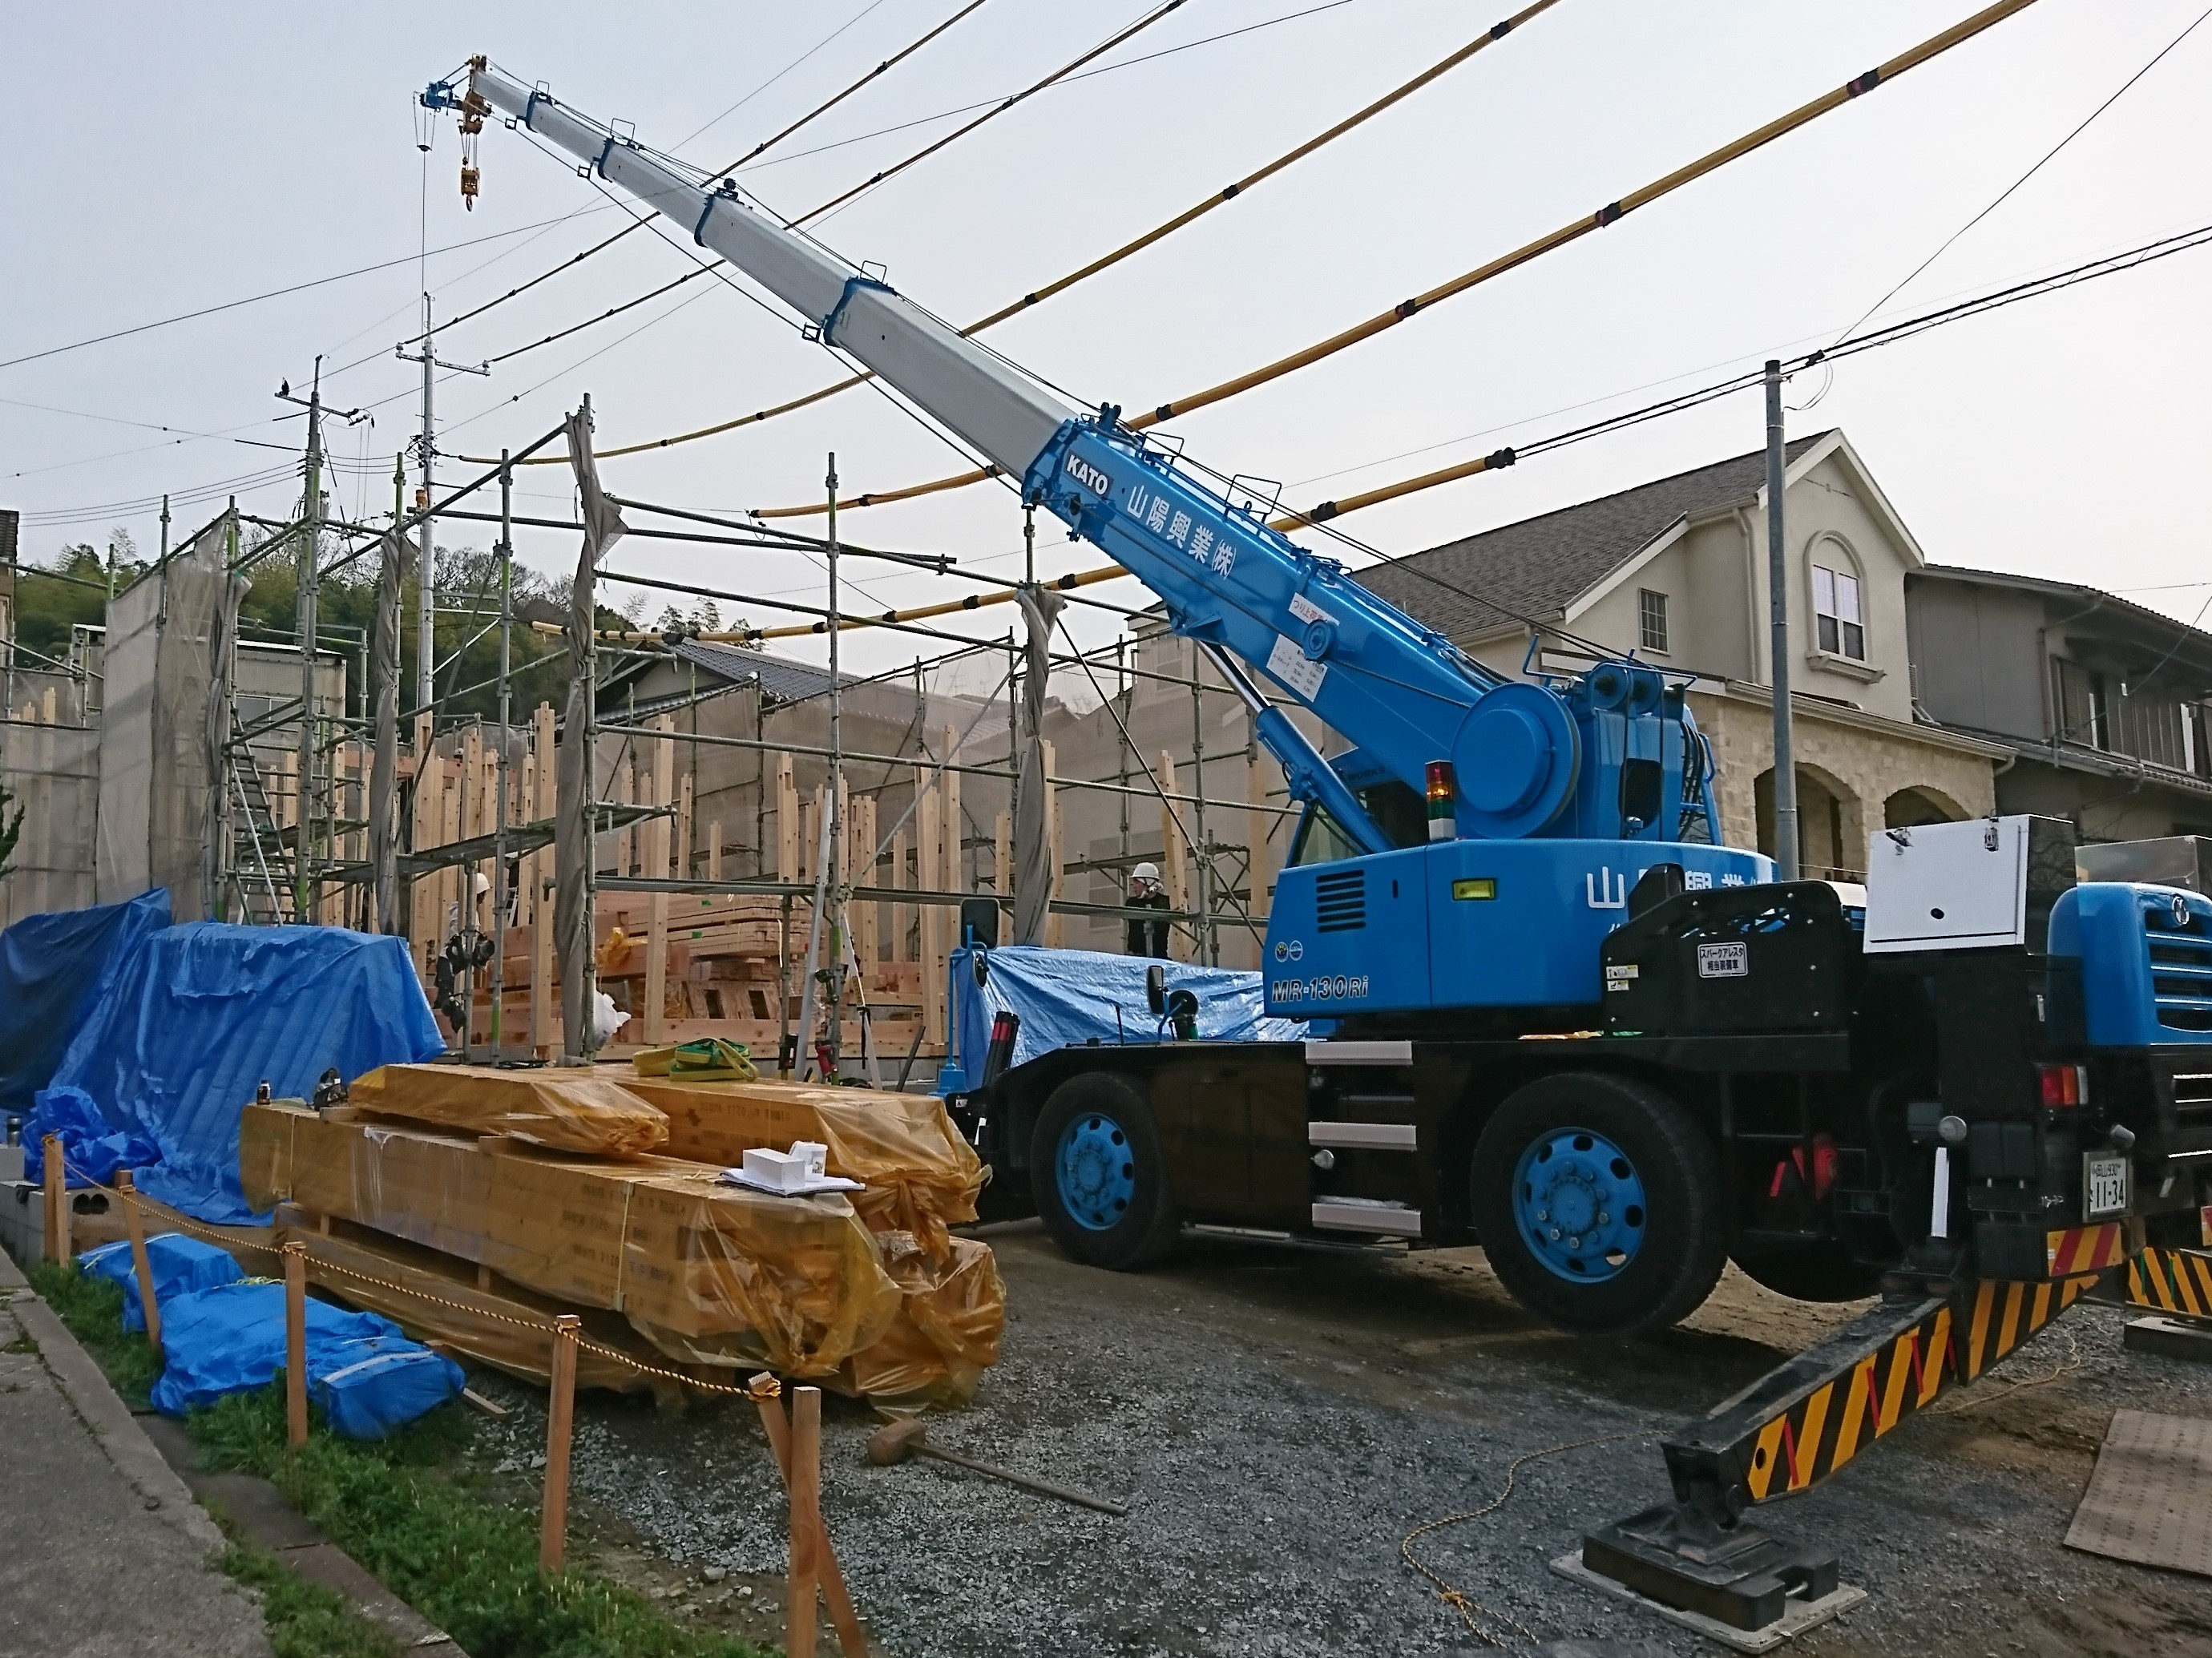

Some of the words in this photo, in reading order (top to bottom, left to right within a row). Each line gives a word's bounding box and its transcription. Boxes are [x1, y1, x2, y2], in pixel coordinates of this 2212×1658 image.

[1067, 454, 1108, 495] KATO
[1272, 975, 1369, 1003] MR-130Ri
[2097, 1179, 2124, 1208] 11-34
